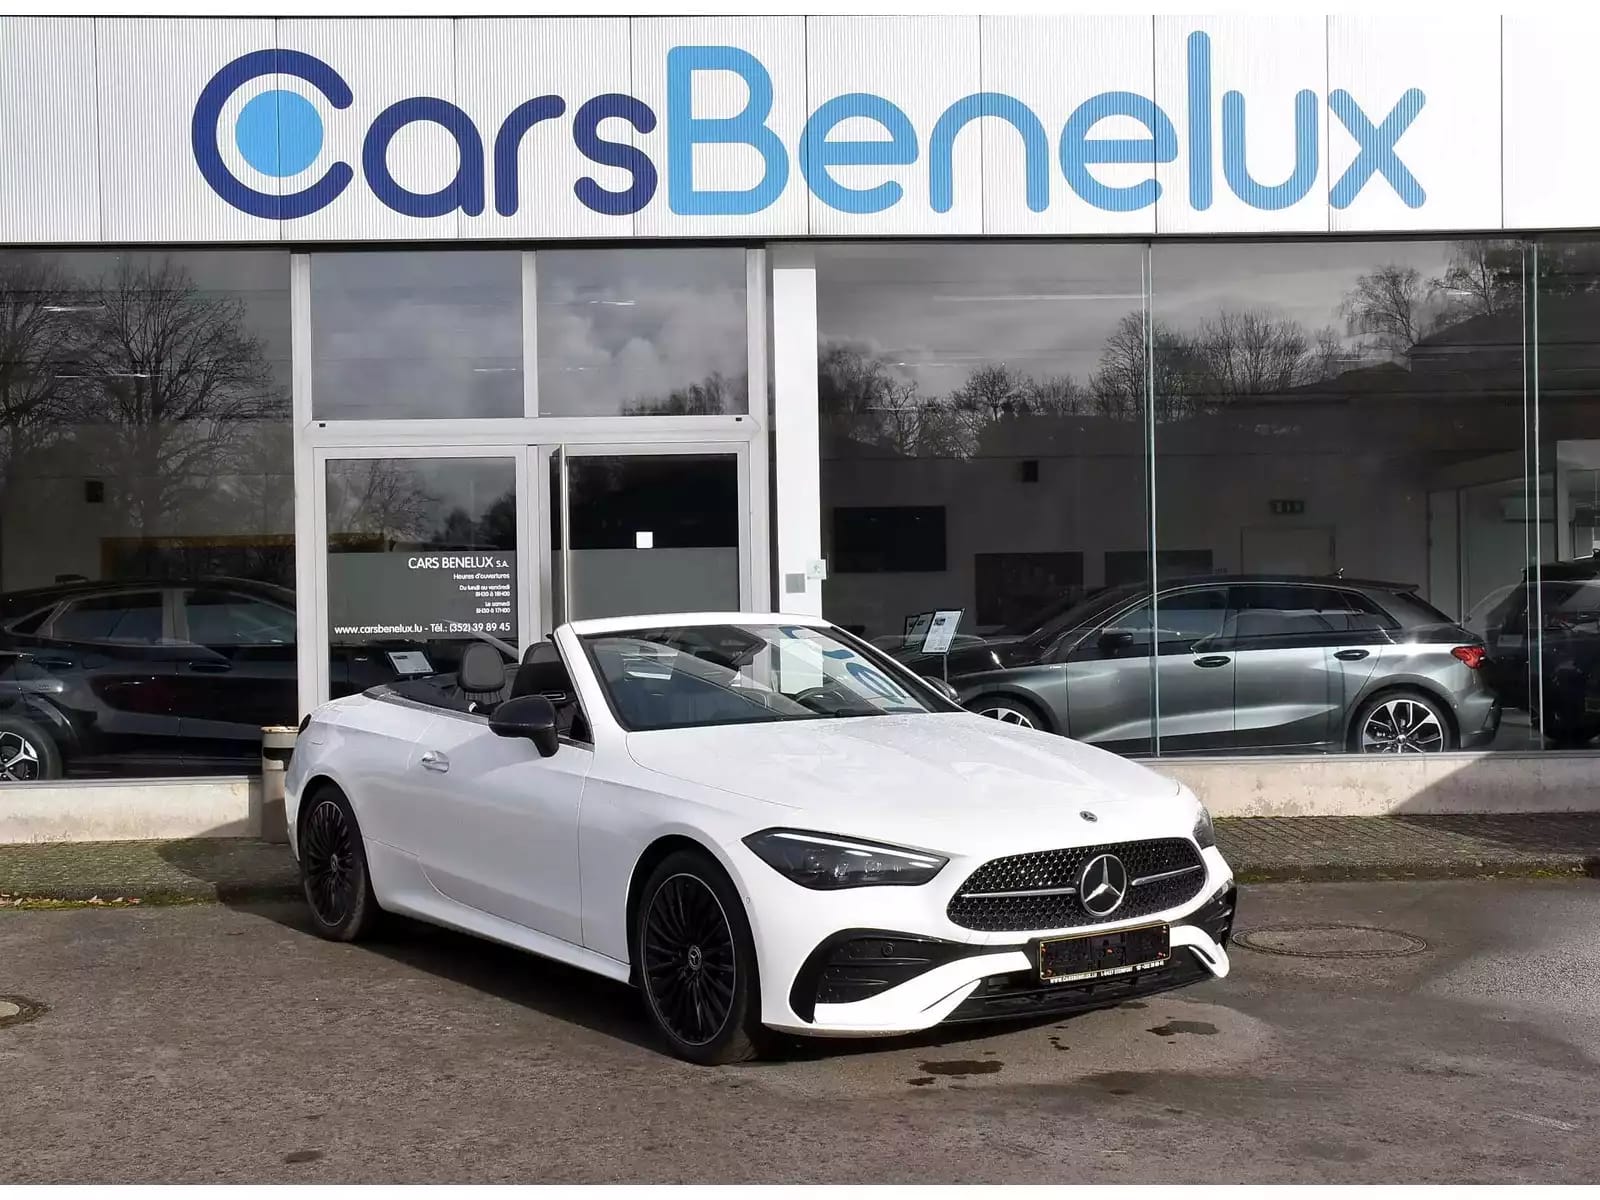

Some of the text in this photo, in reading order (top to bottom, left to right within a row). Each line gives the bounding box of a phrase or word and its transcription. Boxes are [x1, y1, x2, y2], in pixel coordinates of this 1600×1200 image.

[408, 556, 509, 569] CARS BENELUX S.A.
[334, 623, 423, 635] www.carsbenelux.lu
[449, 623, 471, 633] (352)
[471, 623, 483, 632] 39
[485, 623, 498, 632] 89
[498, 623, 511, 632] 45
